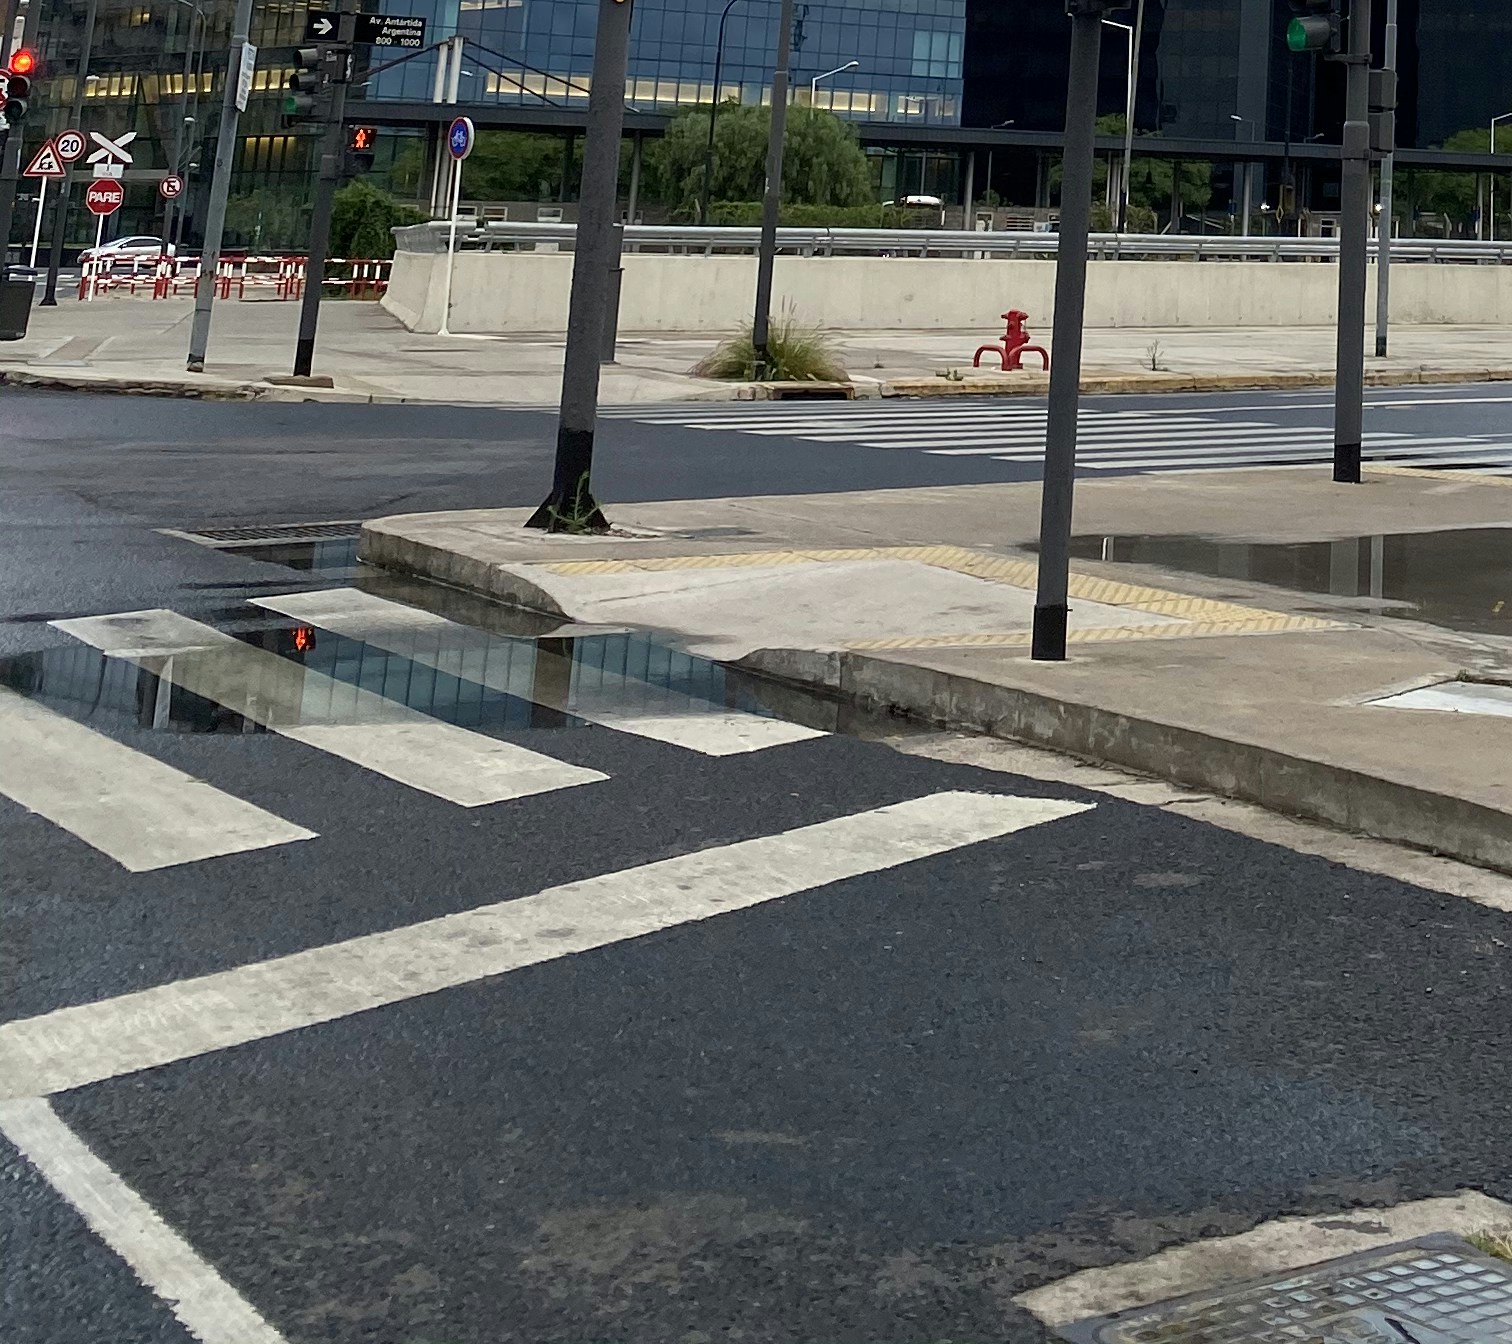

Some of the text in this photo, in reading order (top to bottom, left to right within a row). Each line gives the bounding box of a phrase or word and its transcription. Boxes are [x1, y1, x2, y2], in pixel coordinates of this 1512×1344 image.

[381, 26, 422, 37] Argentina
[400, 38, 421, 47] 1000
[60, 139, 80, 153] 20
[88, 191, 121, 203] PARE
